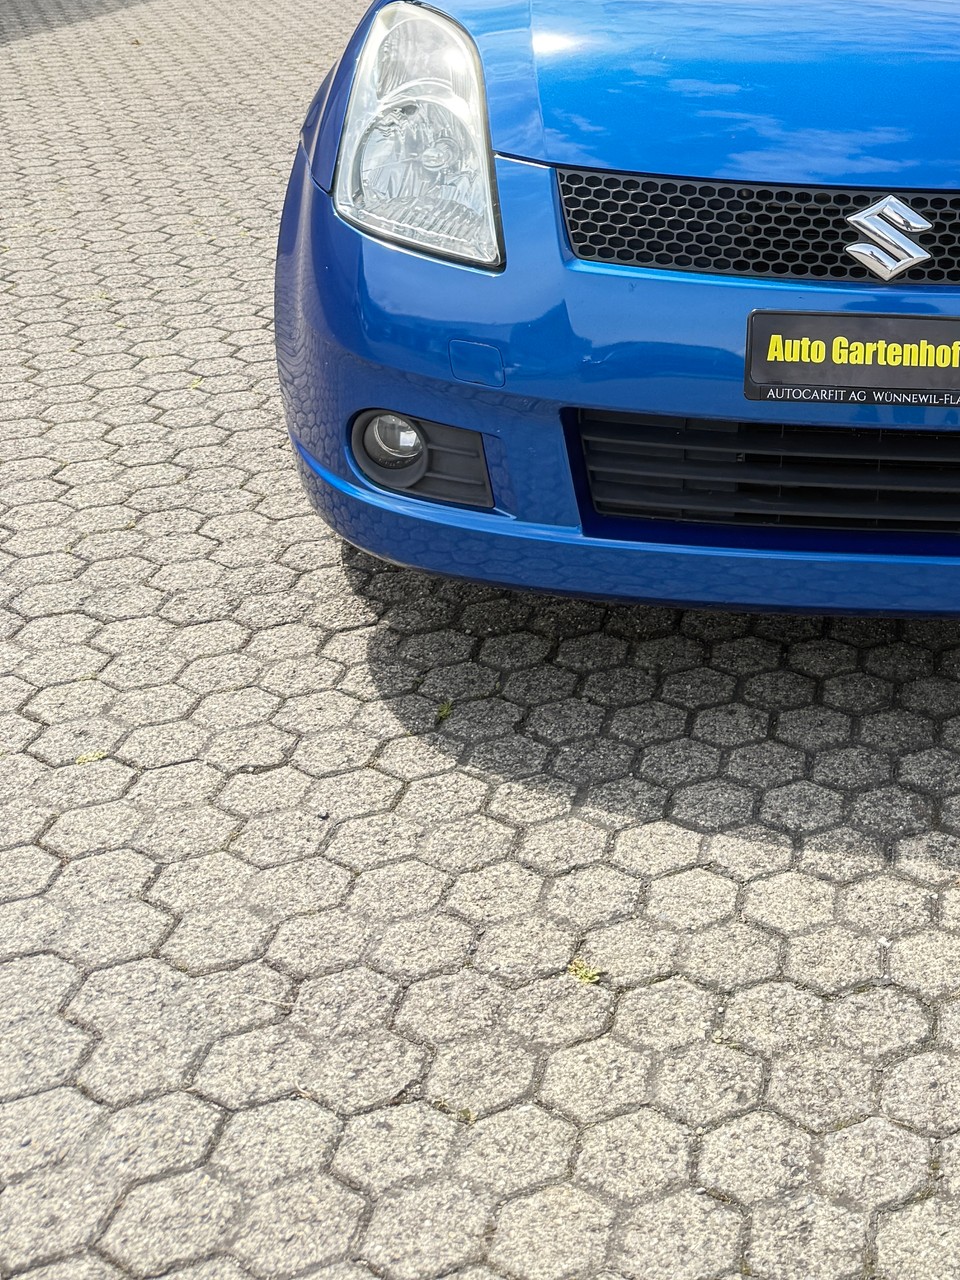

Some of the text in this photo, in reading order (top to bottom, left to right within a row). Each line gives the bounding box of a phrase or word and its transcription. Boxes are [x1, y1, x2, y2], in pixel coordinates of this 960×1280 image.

[767, 334, 826, 363] Auto
[832, 336, 960, 368] Gartenhof
[766, 388, 847, 401] AUTOCARFIT
[848, 390, 867, 402] AG
